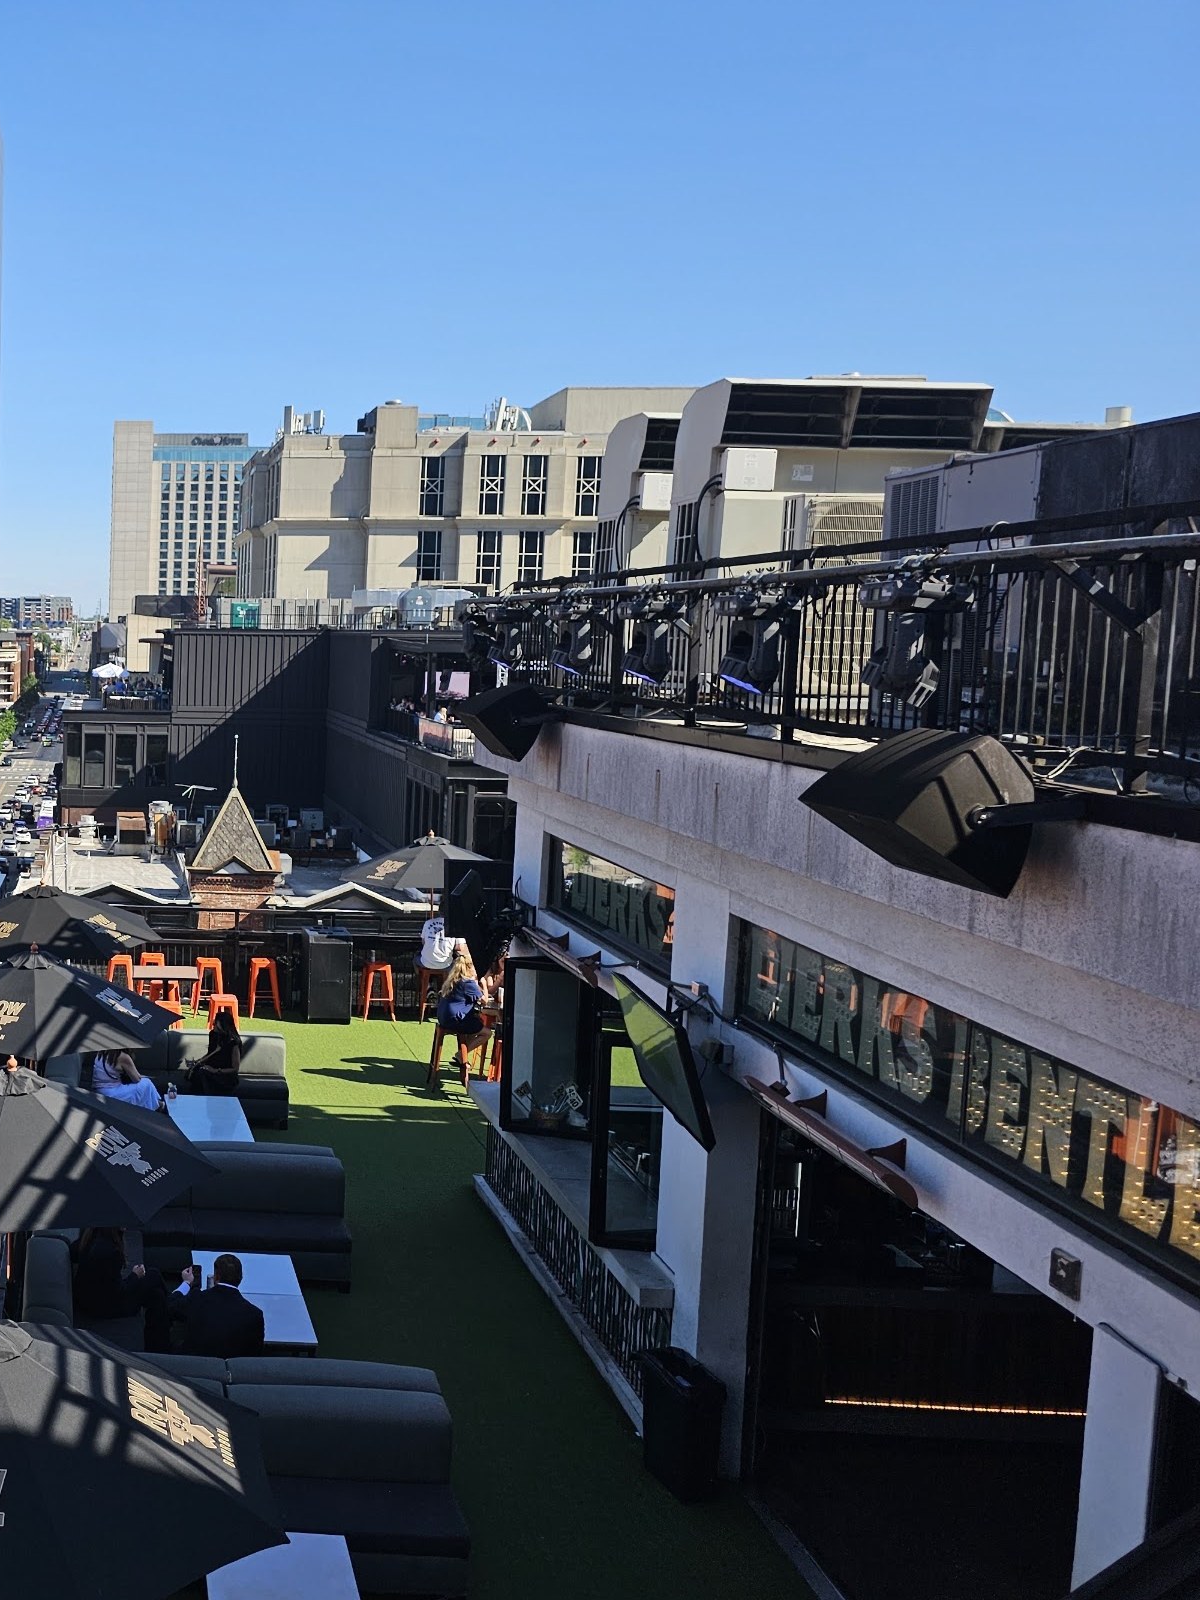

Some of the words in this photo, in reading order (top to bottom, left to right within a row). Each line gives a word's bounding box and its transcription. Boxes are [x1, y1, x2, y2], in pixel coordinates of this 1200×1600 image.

[85, 1125, 130, 1157] ROW
[141, 1166, 169, 1187] BOURBON
[127, 1376, 168, 1435] ROW
